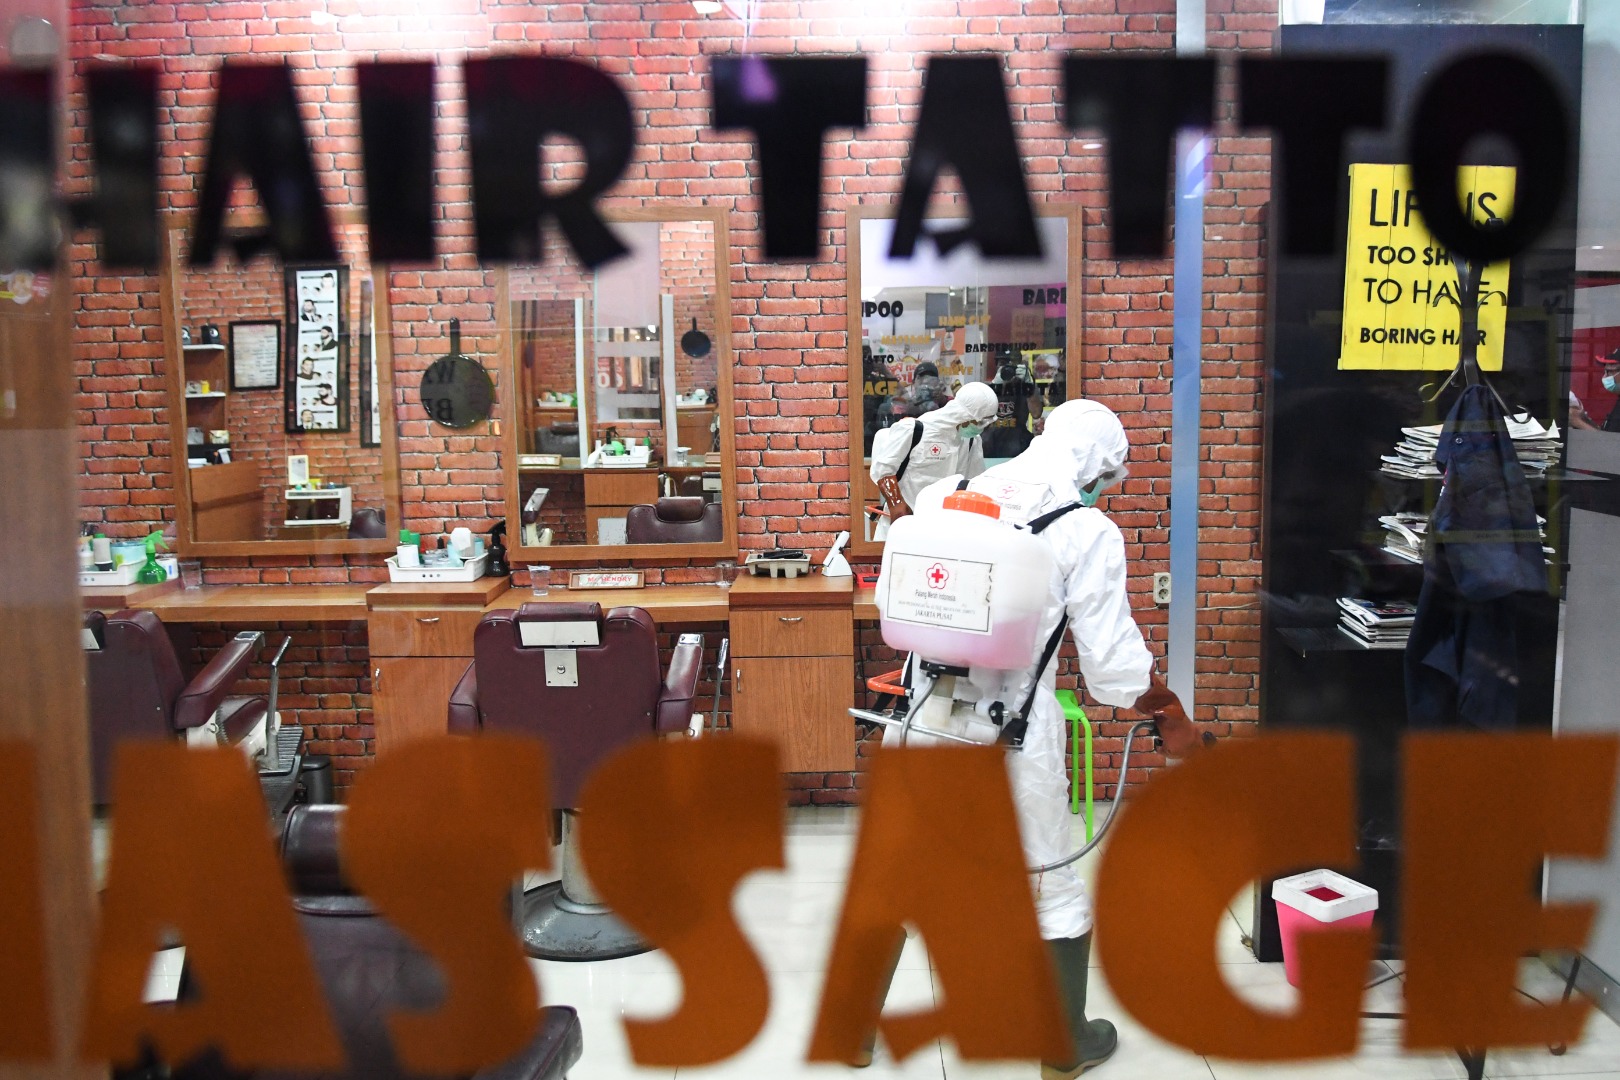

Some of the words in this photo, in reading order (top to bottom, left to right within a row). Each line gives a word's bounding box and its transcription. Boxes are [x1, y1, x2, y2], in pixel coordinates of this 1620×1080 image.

[0, 56, 636, 266] HAIR
[712, 50, 1570, 262] TATTO
[1369, 188, 1434, 227] LIF
[1367, 246, 1416, 265] TOO
[1364, 278, 1403, 304] TO
[861, 301, 904, 318] POO
[1360, 328, 1436, 345] BORING
[915, 610, 936, 619] JAKARTA
